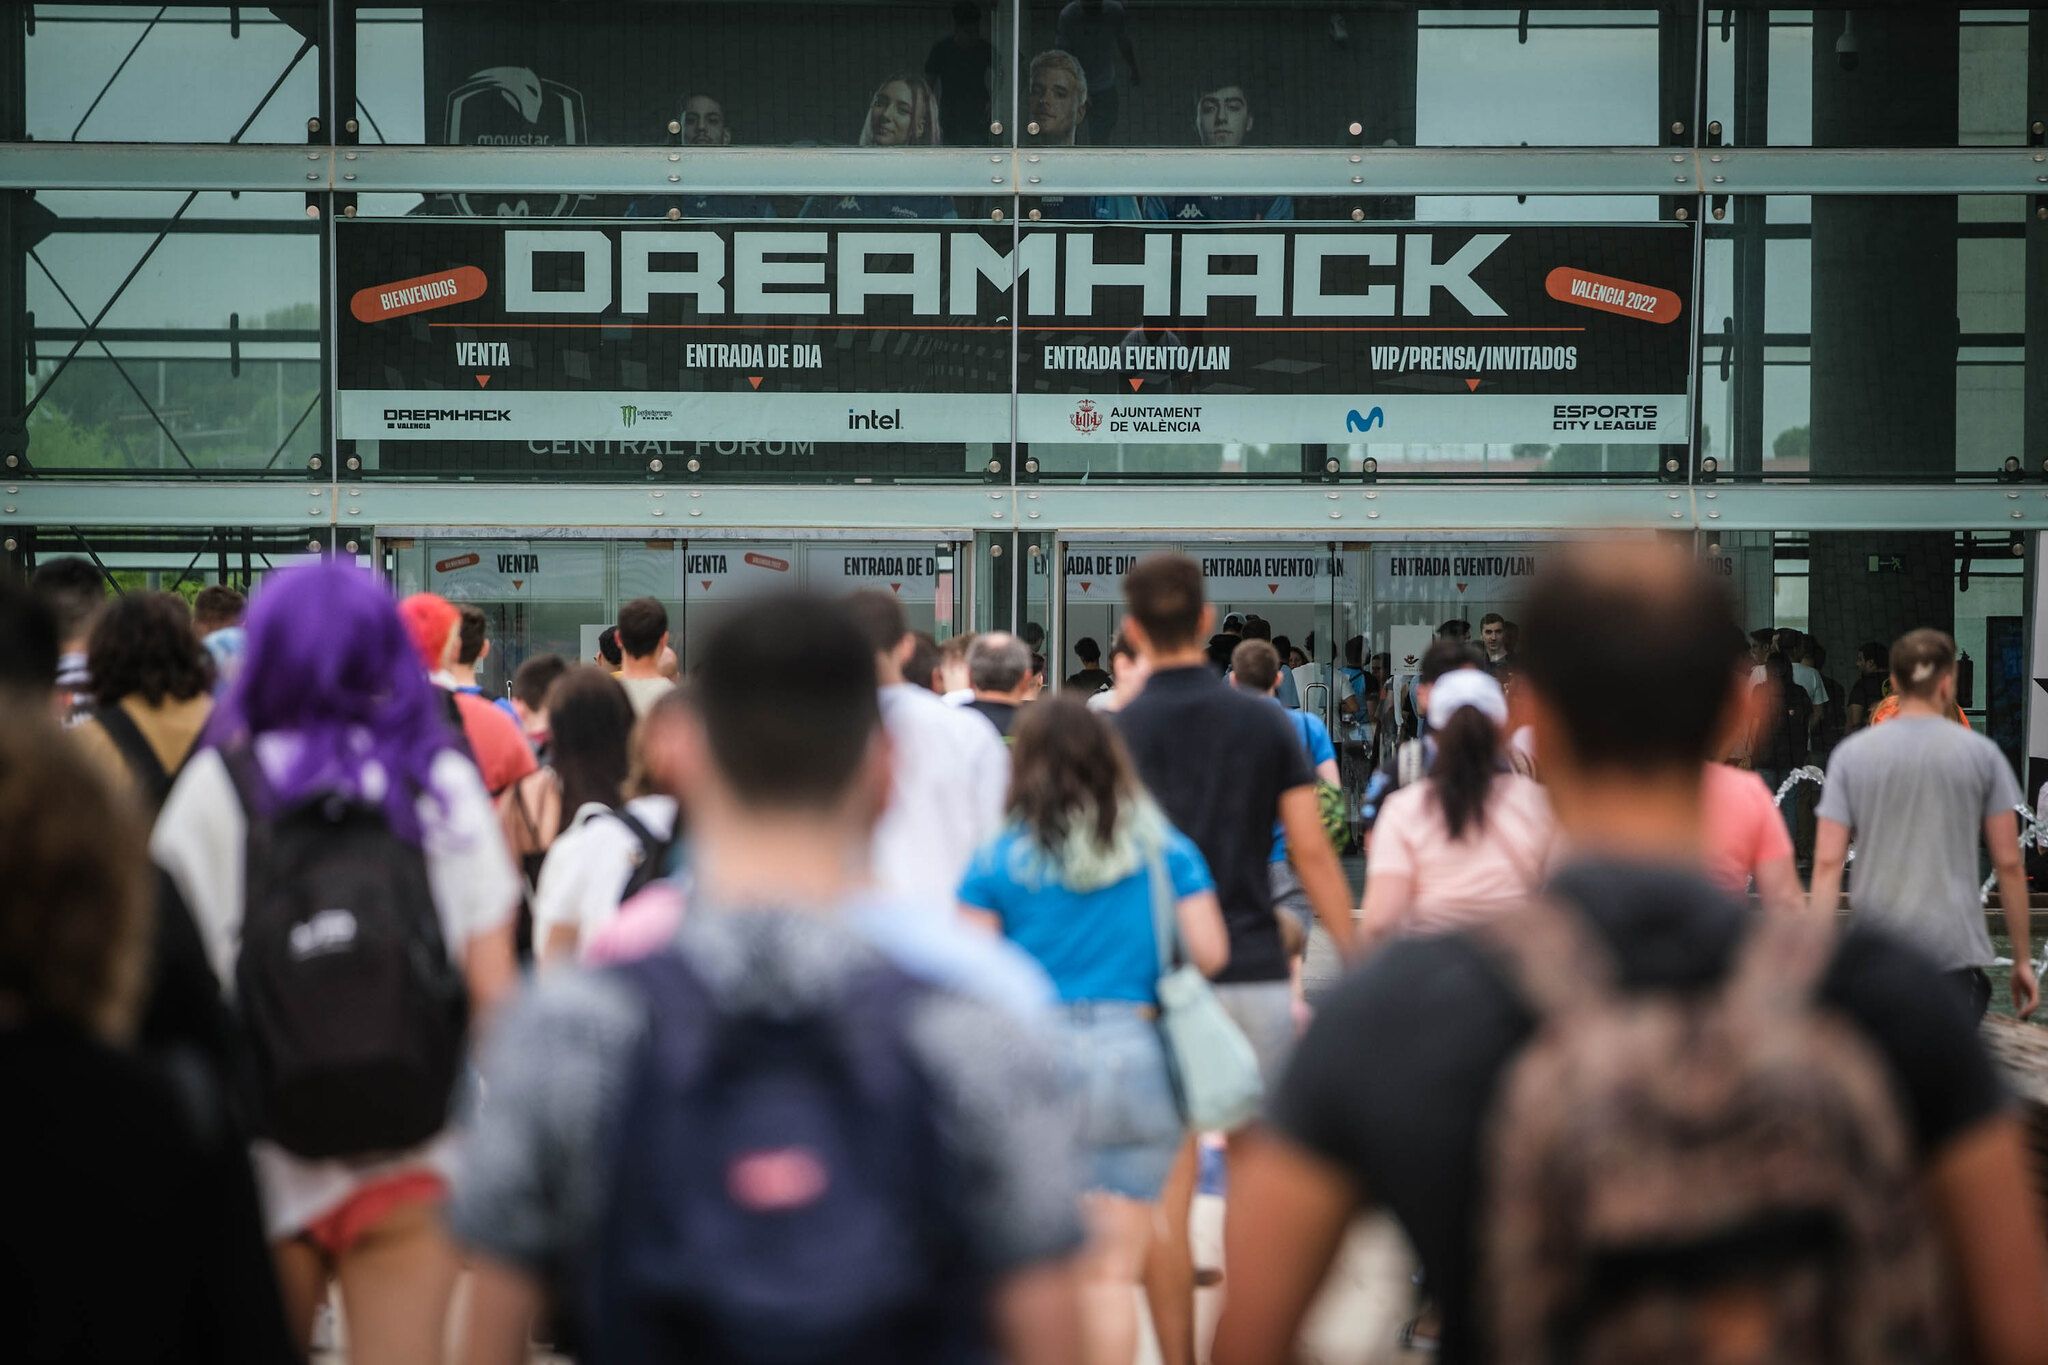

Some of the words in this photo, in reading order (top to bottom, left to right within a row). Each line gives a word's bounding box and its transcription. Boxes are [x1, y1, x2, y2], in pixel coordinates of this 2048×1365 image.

[477, 133, 550, 145] movistar
[505, 230, 1512, 317] DREAMHACK
[380, 278, 457, 311] BIENVENIDOS
[1625, 291, 1658, 314] 2022
[456, 342, 510, 367] VENTA
[686, 343, 764, 368] ENTRADA
[767, 343, 789, 368] DE
[793, 344, 823, 368] DIA
[1044, 345, 1122, 370] ENTRADA
[1125, 345, 1230, 372] EVENTO/LAN
[1370, 346, 1577, 372] VIP/PRENSA/INVITADOS
[383, 409, 512, 422] DREAMHACK
[1110, 407, 1202, 418] AJUNTAMENT
[1553, 405, 1658, 418] ESPORTS
[1110, 421, 1128, 432] DE
[1133, 418, 1201, 432] VALÈNCIA
[1553, 420, 1590, 431] CITY
[1594, 420, 1657, 431] LEAGUE
[528, 440, 685, 455] CENTRAL
[695, 441, 815, 456] FORUM
[497, 554, 539, 574] VENTA
[687, 555, 728, 574] VENTA
[844, 557, 904, 576] ENTRADA
[907, 557, 923, 576] DE
[1097, 557, 1113, 575] DE
[1202, 558, 1262, 577] ENTRADA
[1390, 557, 1450, 577] ENTRADA
[1453, 557, 1535, 578] EVENTO/LAN
